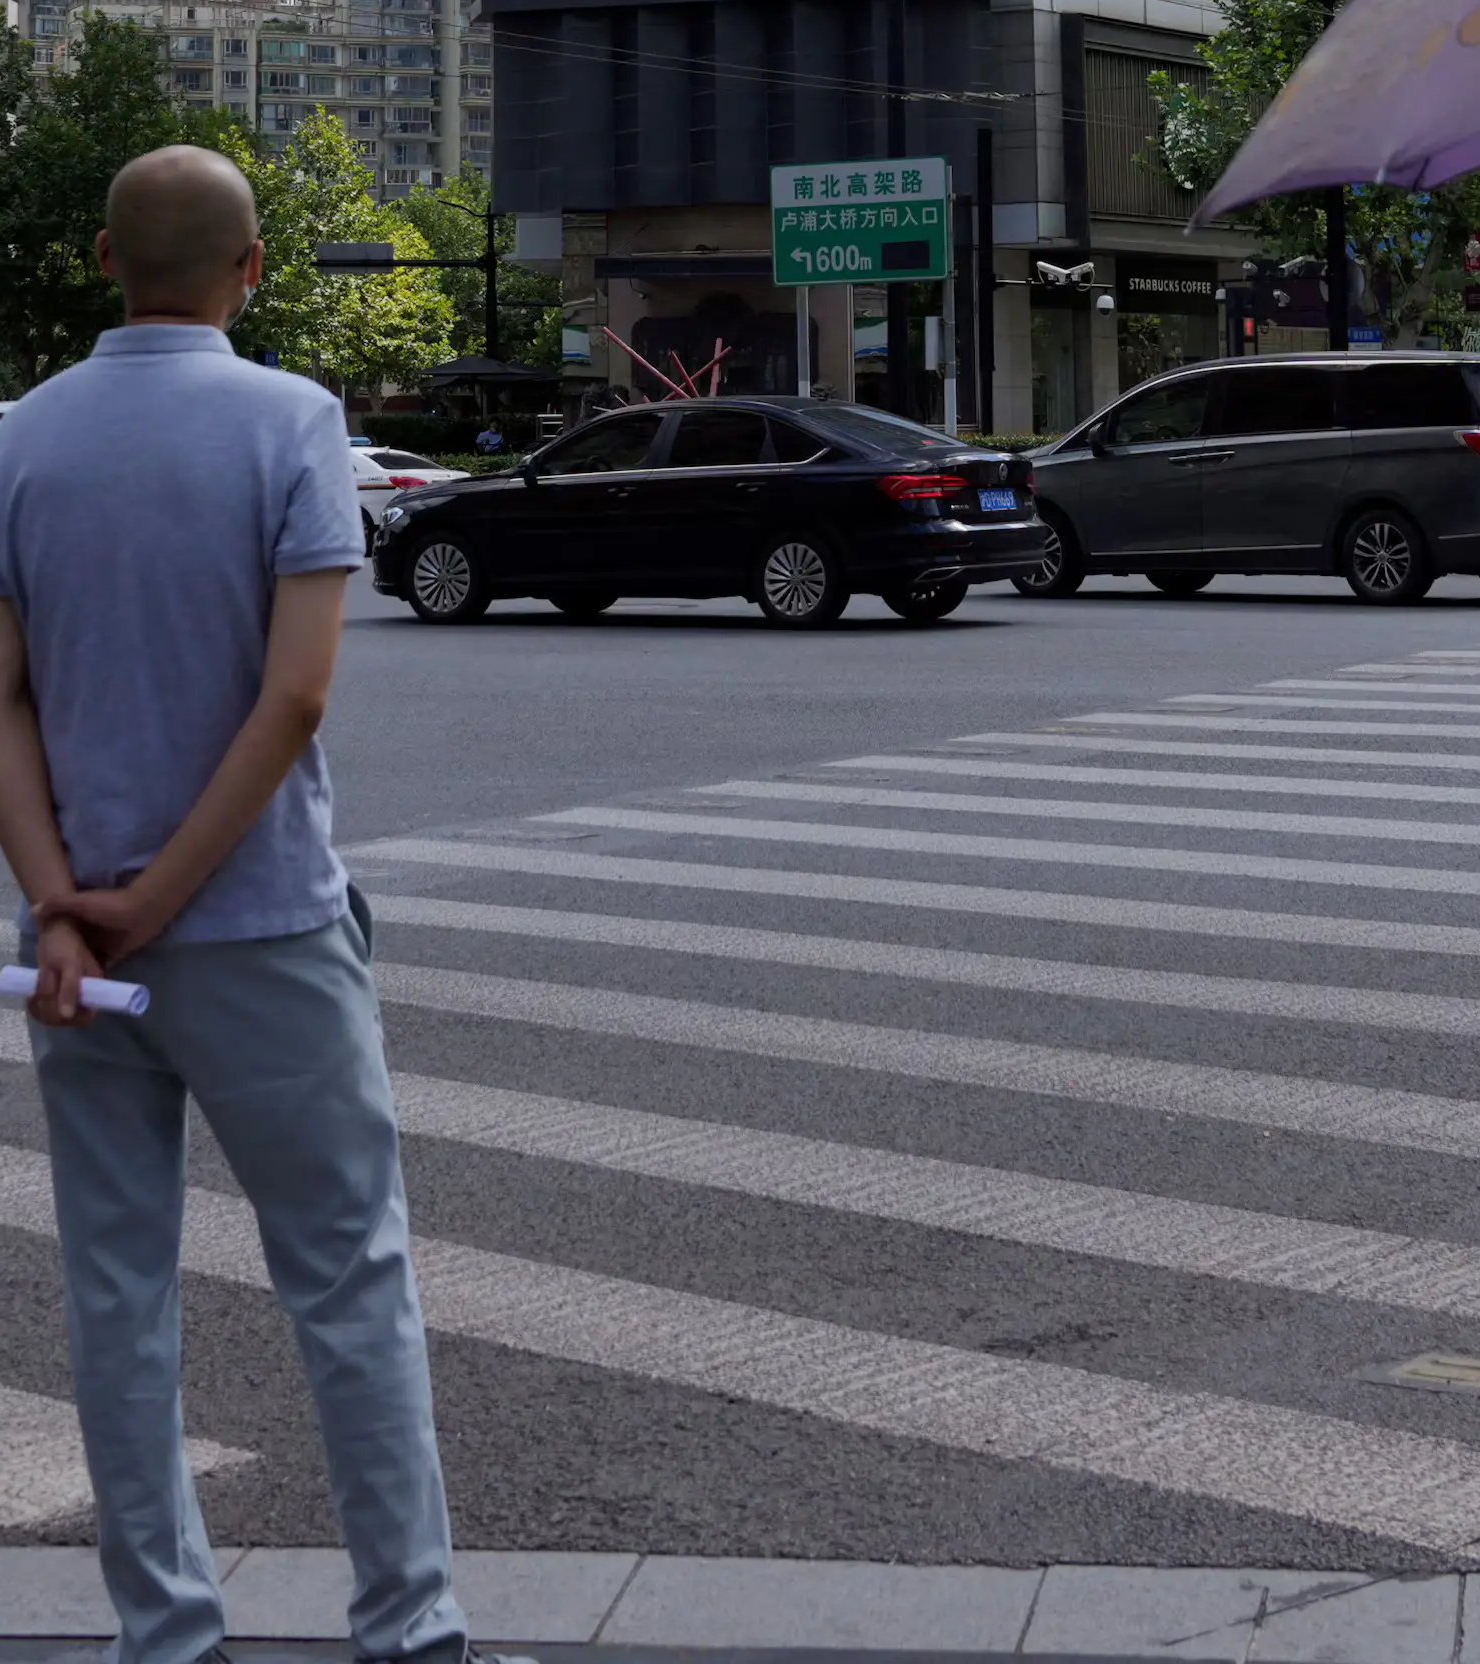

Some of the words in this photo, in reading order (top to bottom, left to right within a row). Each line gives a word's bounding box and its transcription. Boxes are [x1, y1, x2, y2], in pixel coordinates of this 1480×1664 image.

[792, 168, 923, 201] 南北高架路
[780, 206, 939, 234] 卢浦大桥方向入口
[815, 244, 872, 273] 600m
[1129, 278, 1179, 292] STARBUCKS
[1181, 281, 1212, 294] COFFEE
